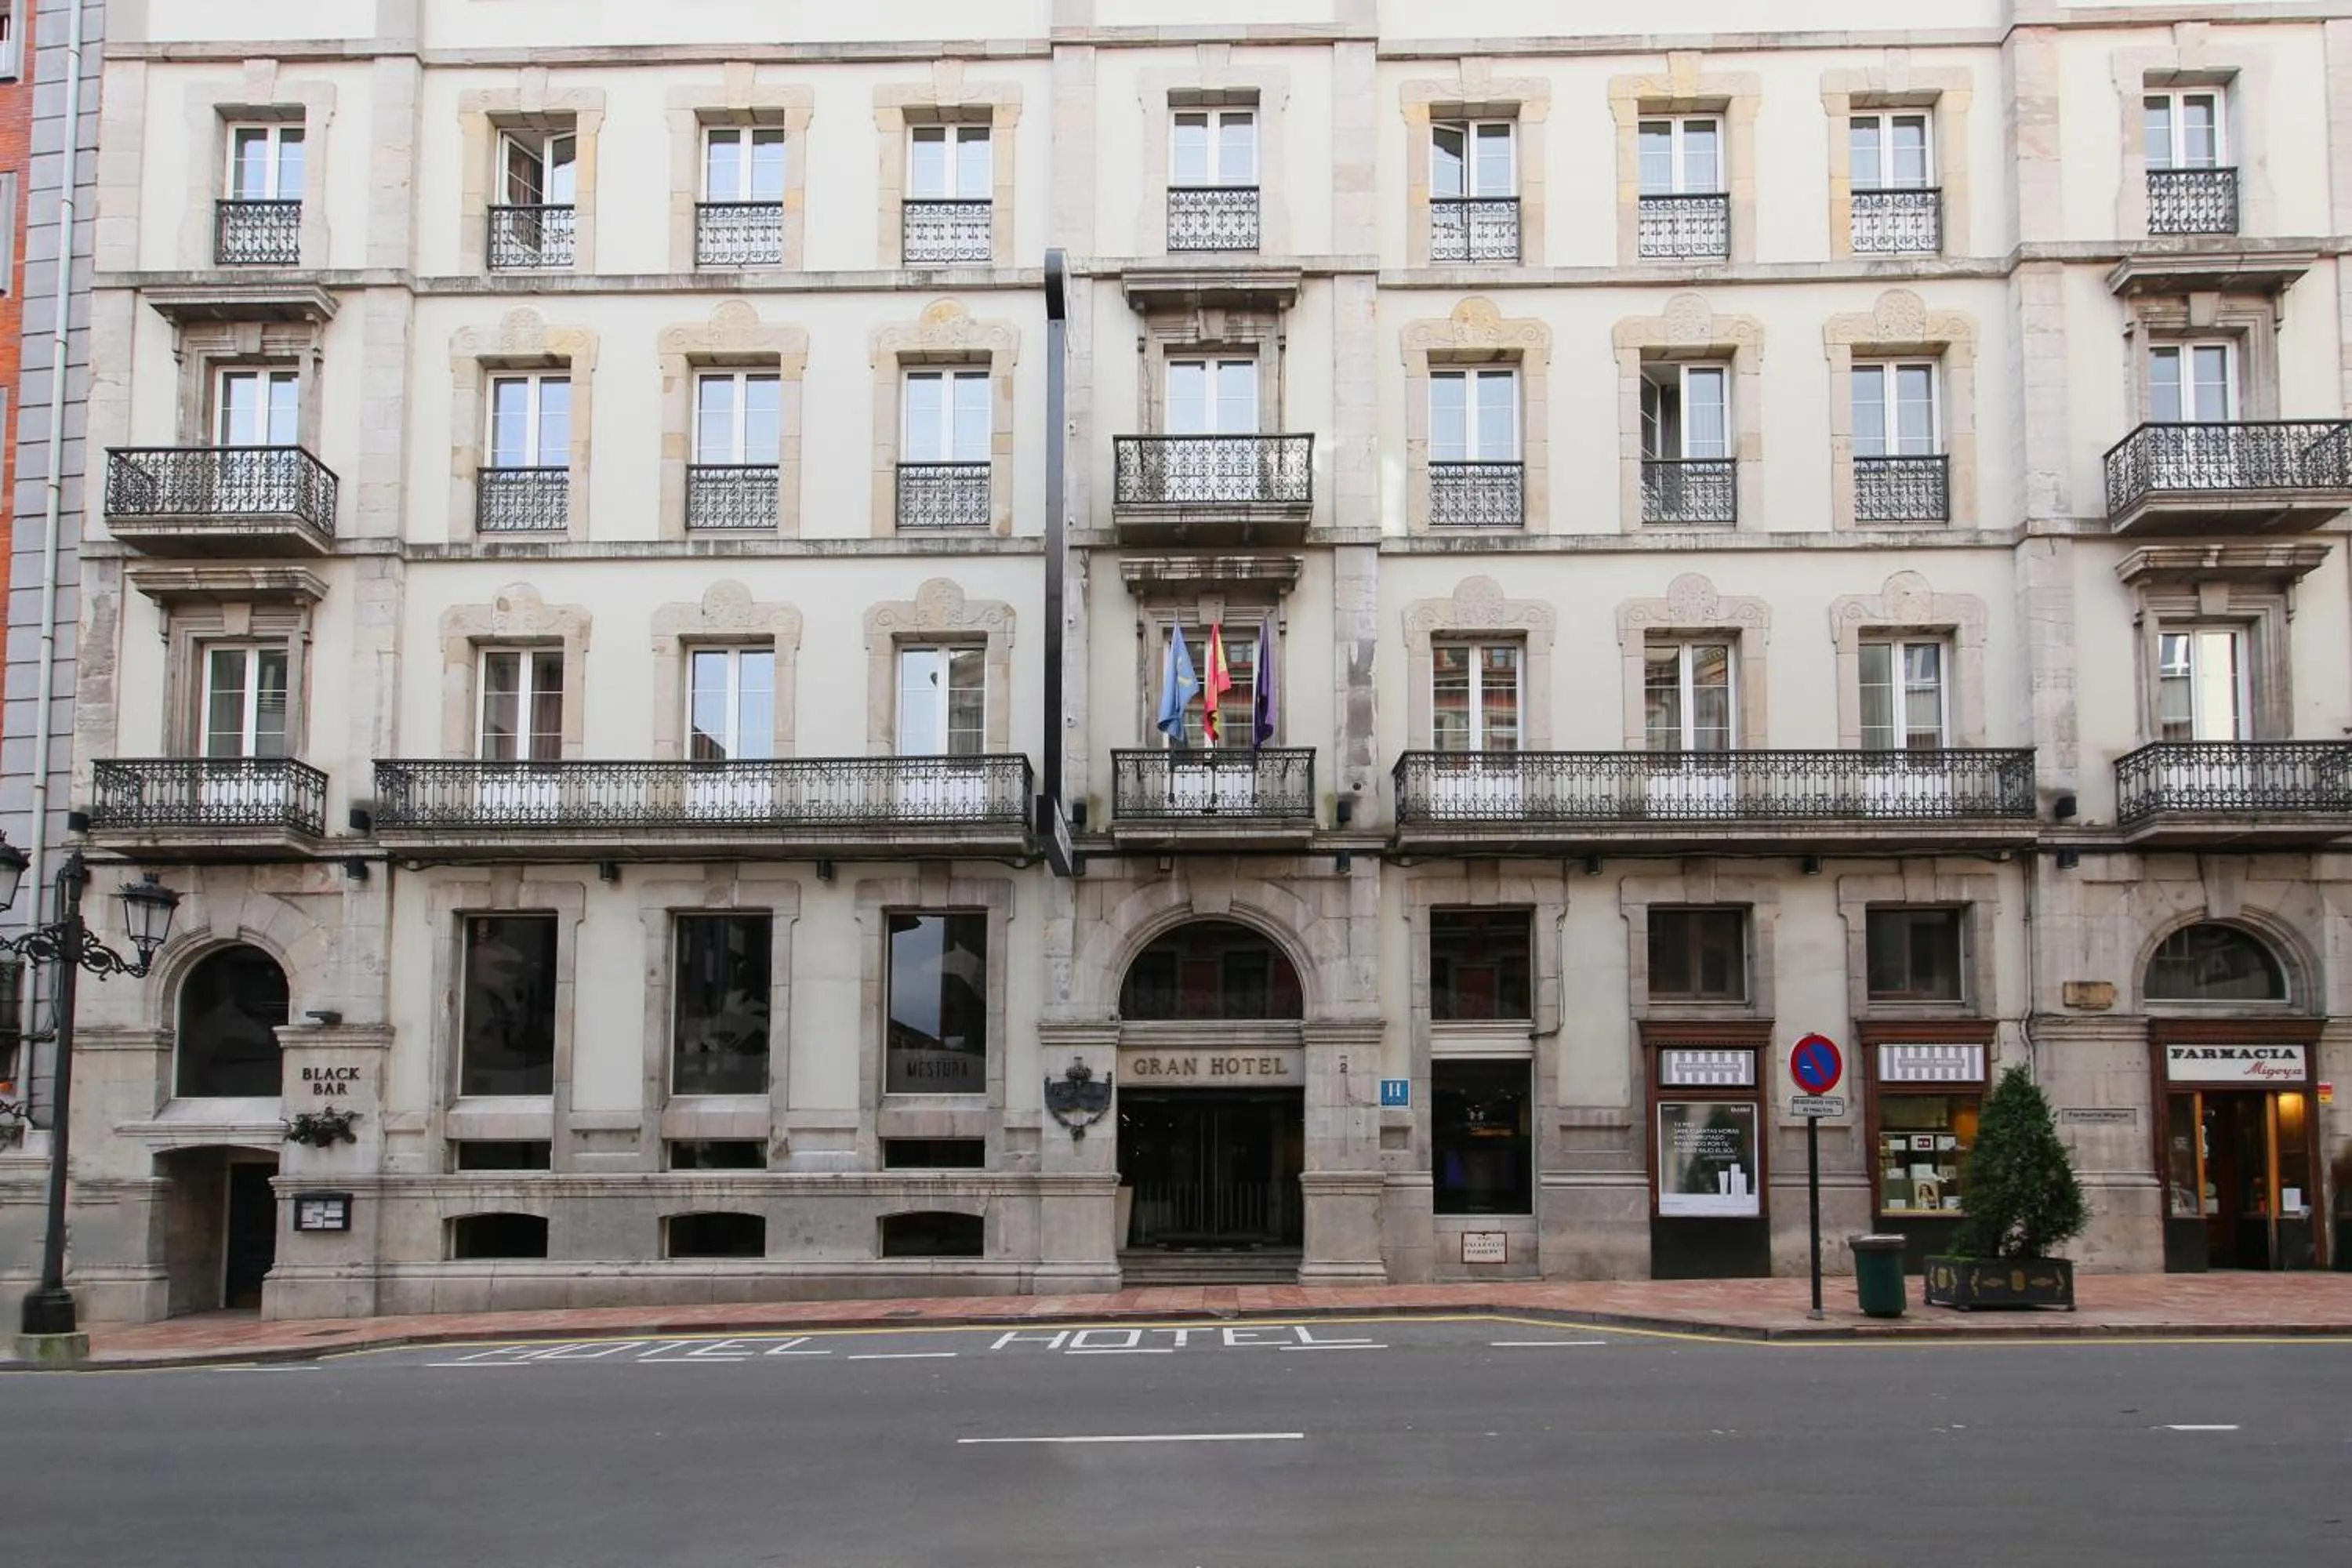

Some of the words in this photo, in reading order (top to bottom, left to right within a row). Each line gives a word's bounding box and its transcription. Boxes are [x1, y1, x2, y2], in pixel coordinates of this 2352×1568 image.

[2170, 1048, 2297, 1059] FARMACIA
[302, 1067, 360, 1081] BLACK
[907, 1061, 967, 1078] MESTURA
[1134, 1058, 1197, 1076] GRAN
[1210, 1058, 1289, 1076] HOTEL
[1339, 1062, 1348, 1073] 2
[2243, 1061, 2303, 1080] Migoya
[314, 1082, 349, 1095] BAR
[990, 1326, 1373, 1349] HOTEL
[456, 1338, 832, 1360] HOTEL
